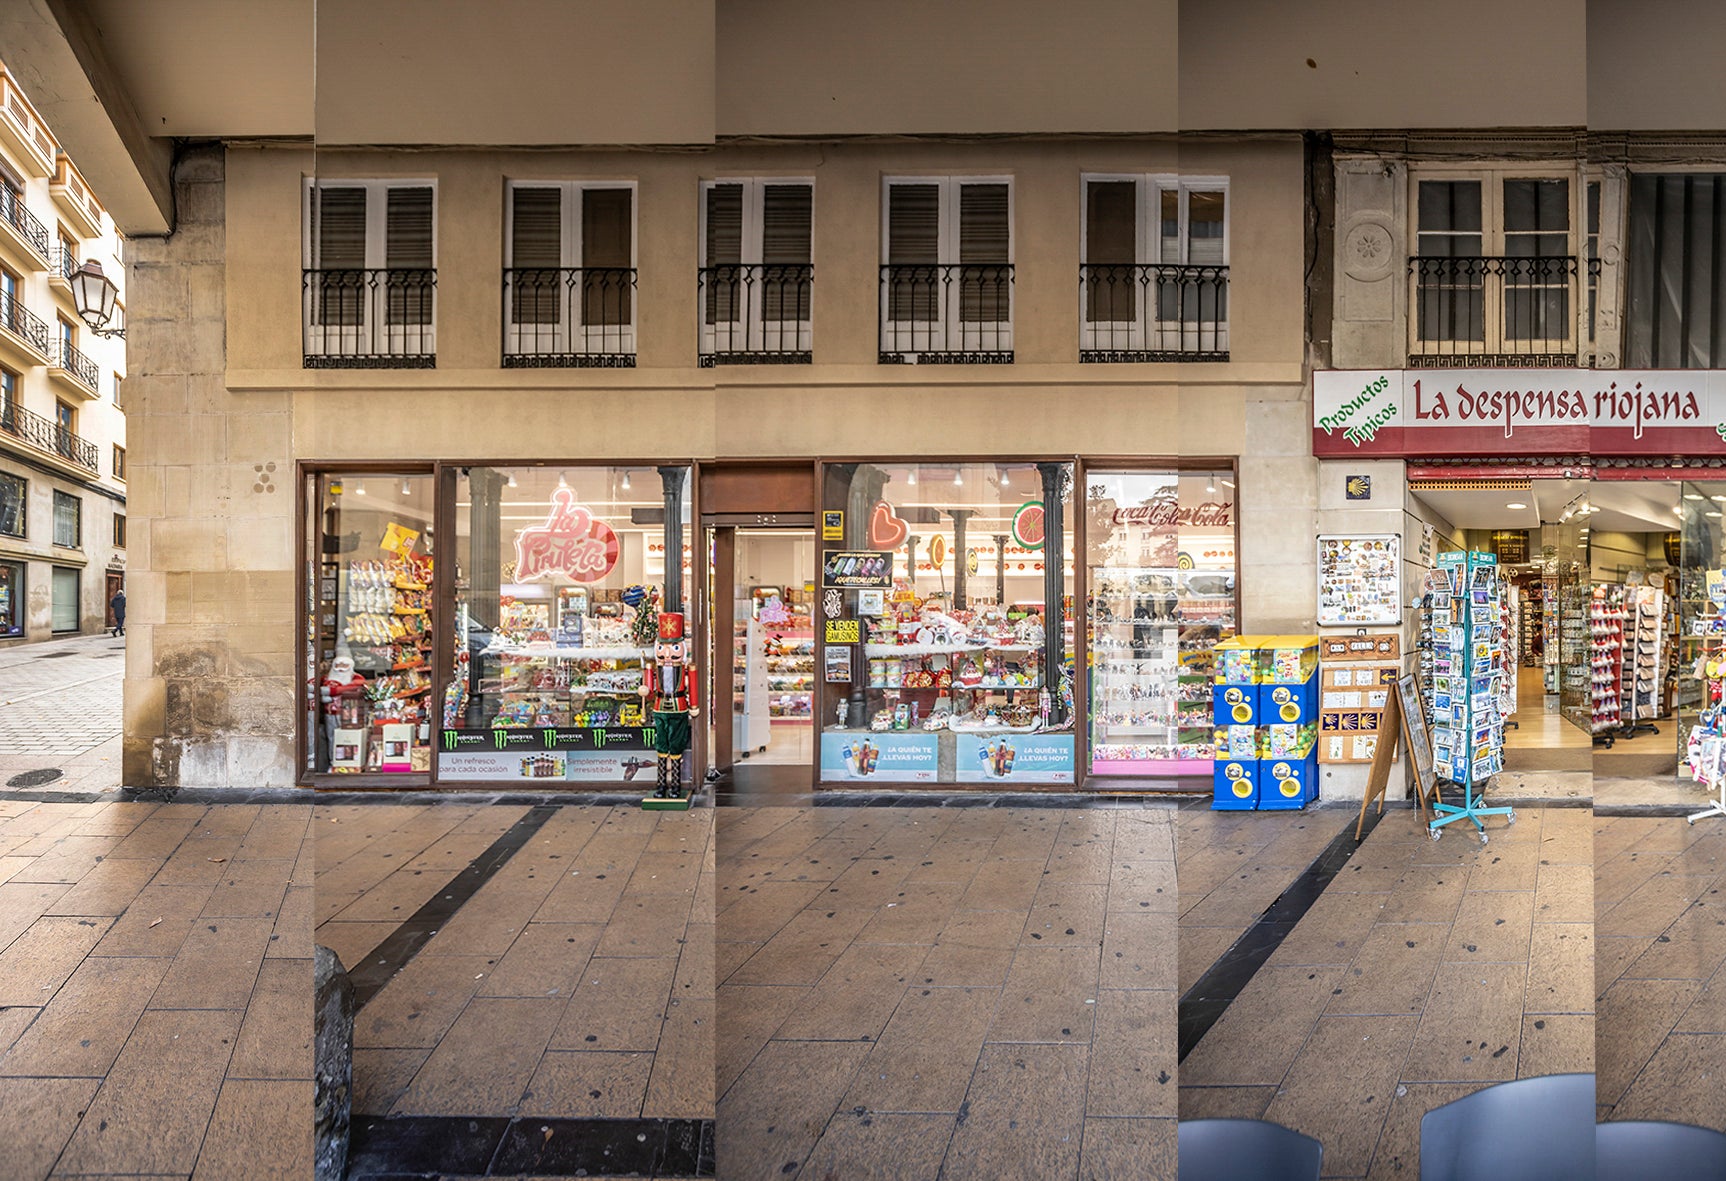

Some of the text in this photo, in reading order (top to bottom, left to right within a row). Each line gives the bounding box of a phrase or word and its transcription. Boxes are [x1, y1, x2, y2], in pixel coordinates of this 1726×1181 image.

[1319, 375, 1389, 435] Productos
[1413, 379, 1700, 439] La despensa riojana
[825, 620, 858, 632] SE VENDEN
[451, 757, 497, 765] Un refresco
[567, 757, 618, 767] Simplemente
[457, 765, 469, 774] cada
[469, 765, 508, 774] ocasión
